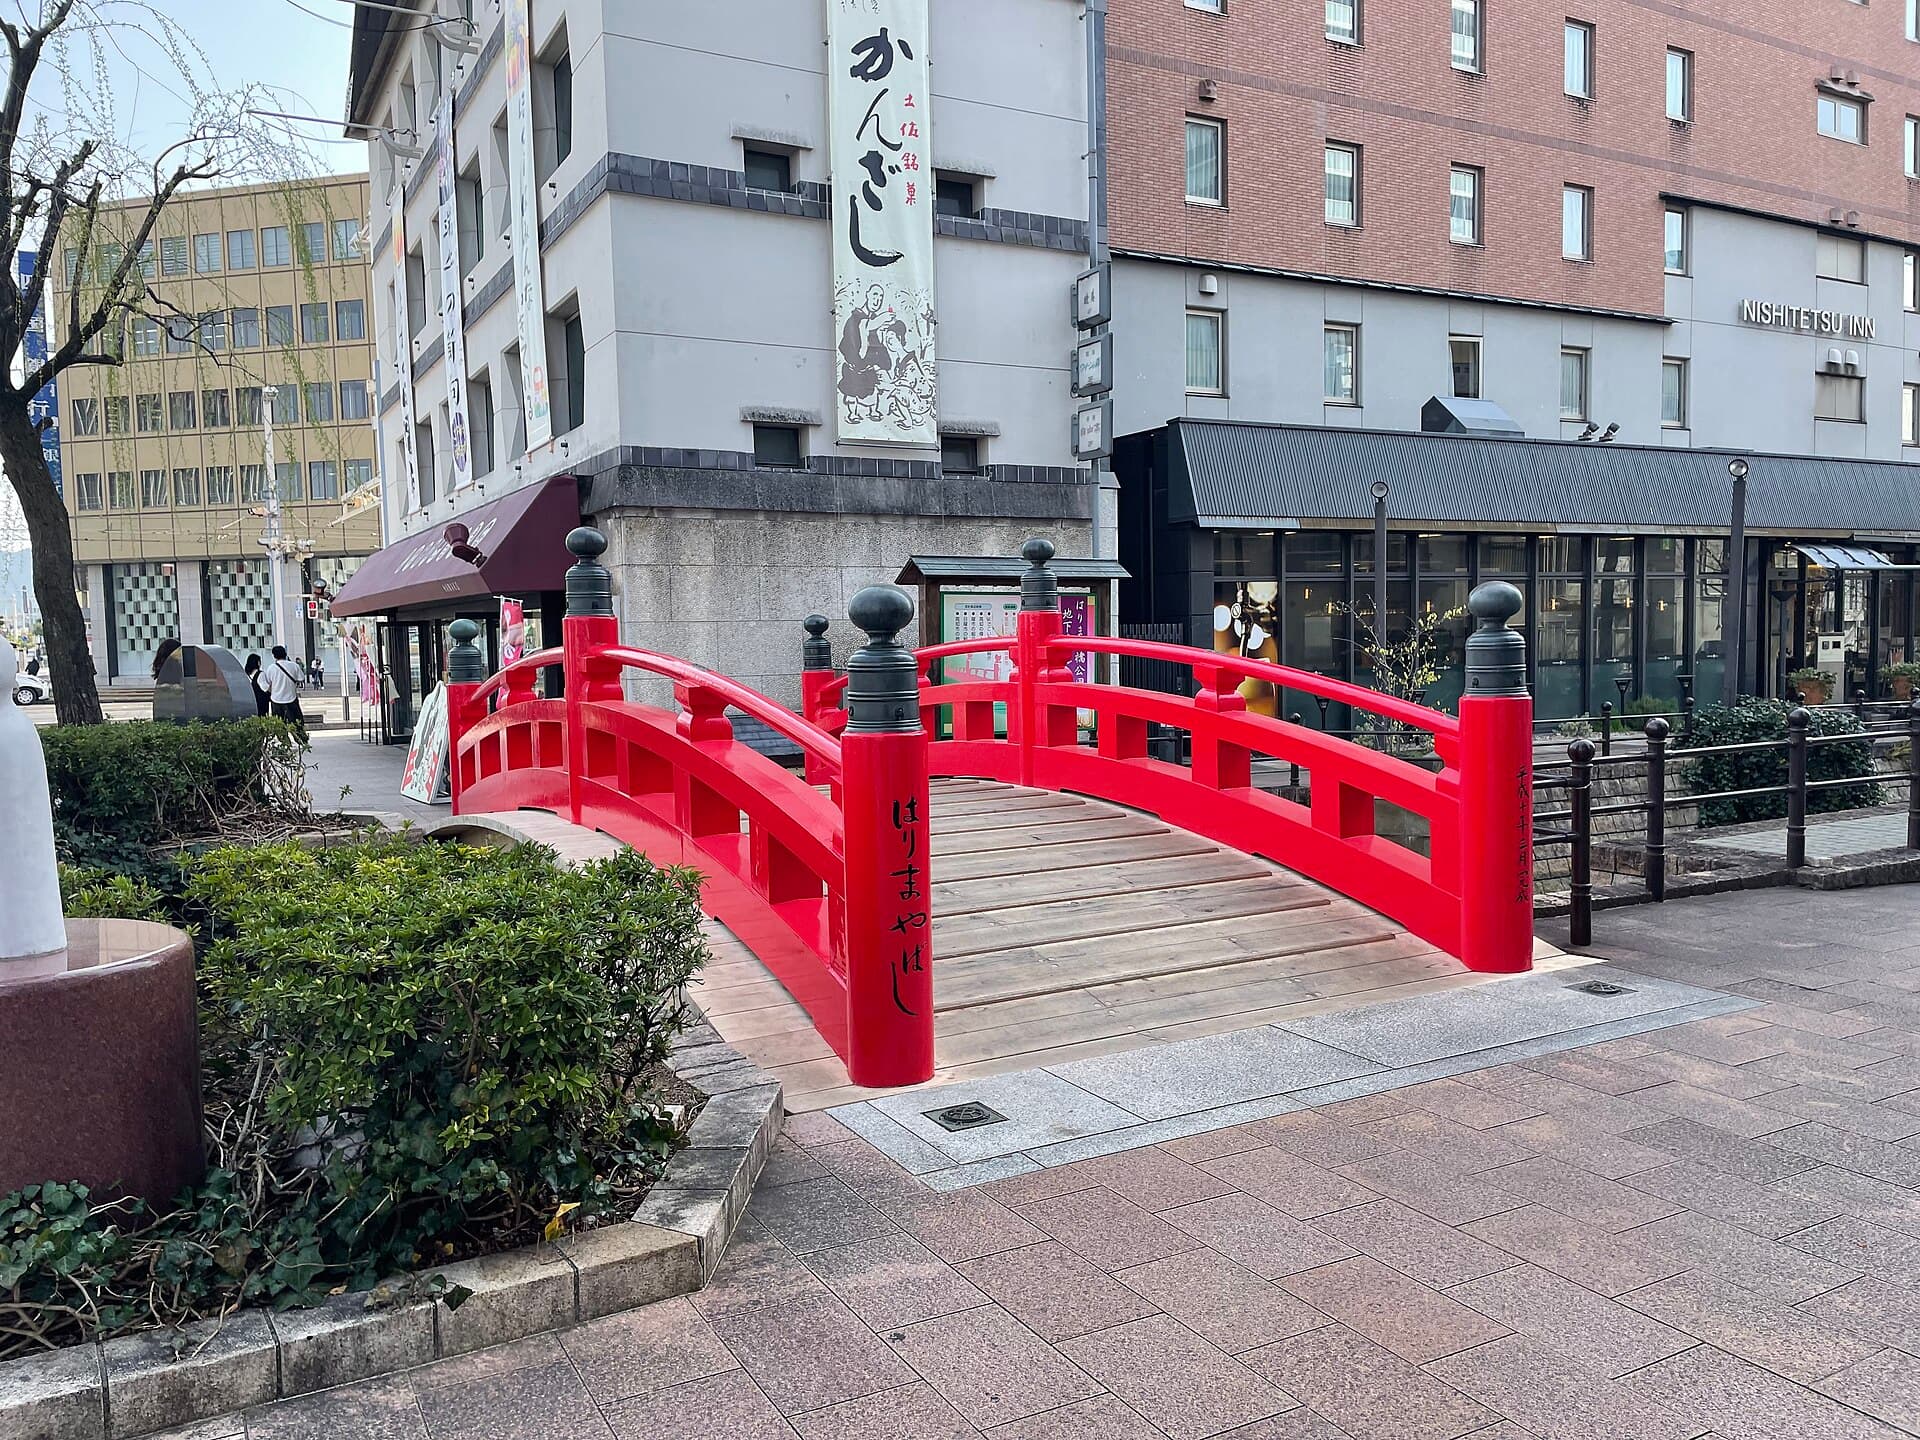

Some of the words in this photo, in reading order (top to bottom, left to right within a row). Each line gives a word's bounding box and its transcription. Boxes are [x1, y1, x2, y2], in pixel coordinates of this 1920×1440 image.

[848, 26, 913, 268] かんざし
[900, 93, 920, 206] 土佐銘菓
[1743, 299, 1843, 334] NISHITETSU
[1849, 314, 1876, 339] INN
[1074, 600, 1087, 683] はりま橋公
[888, 796, 928, 1018] はりまやばし
